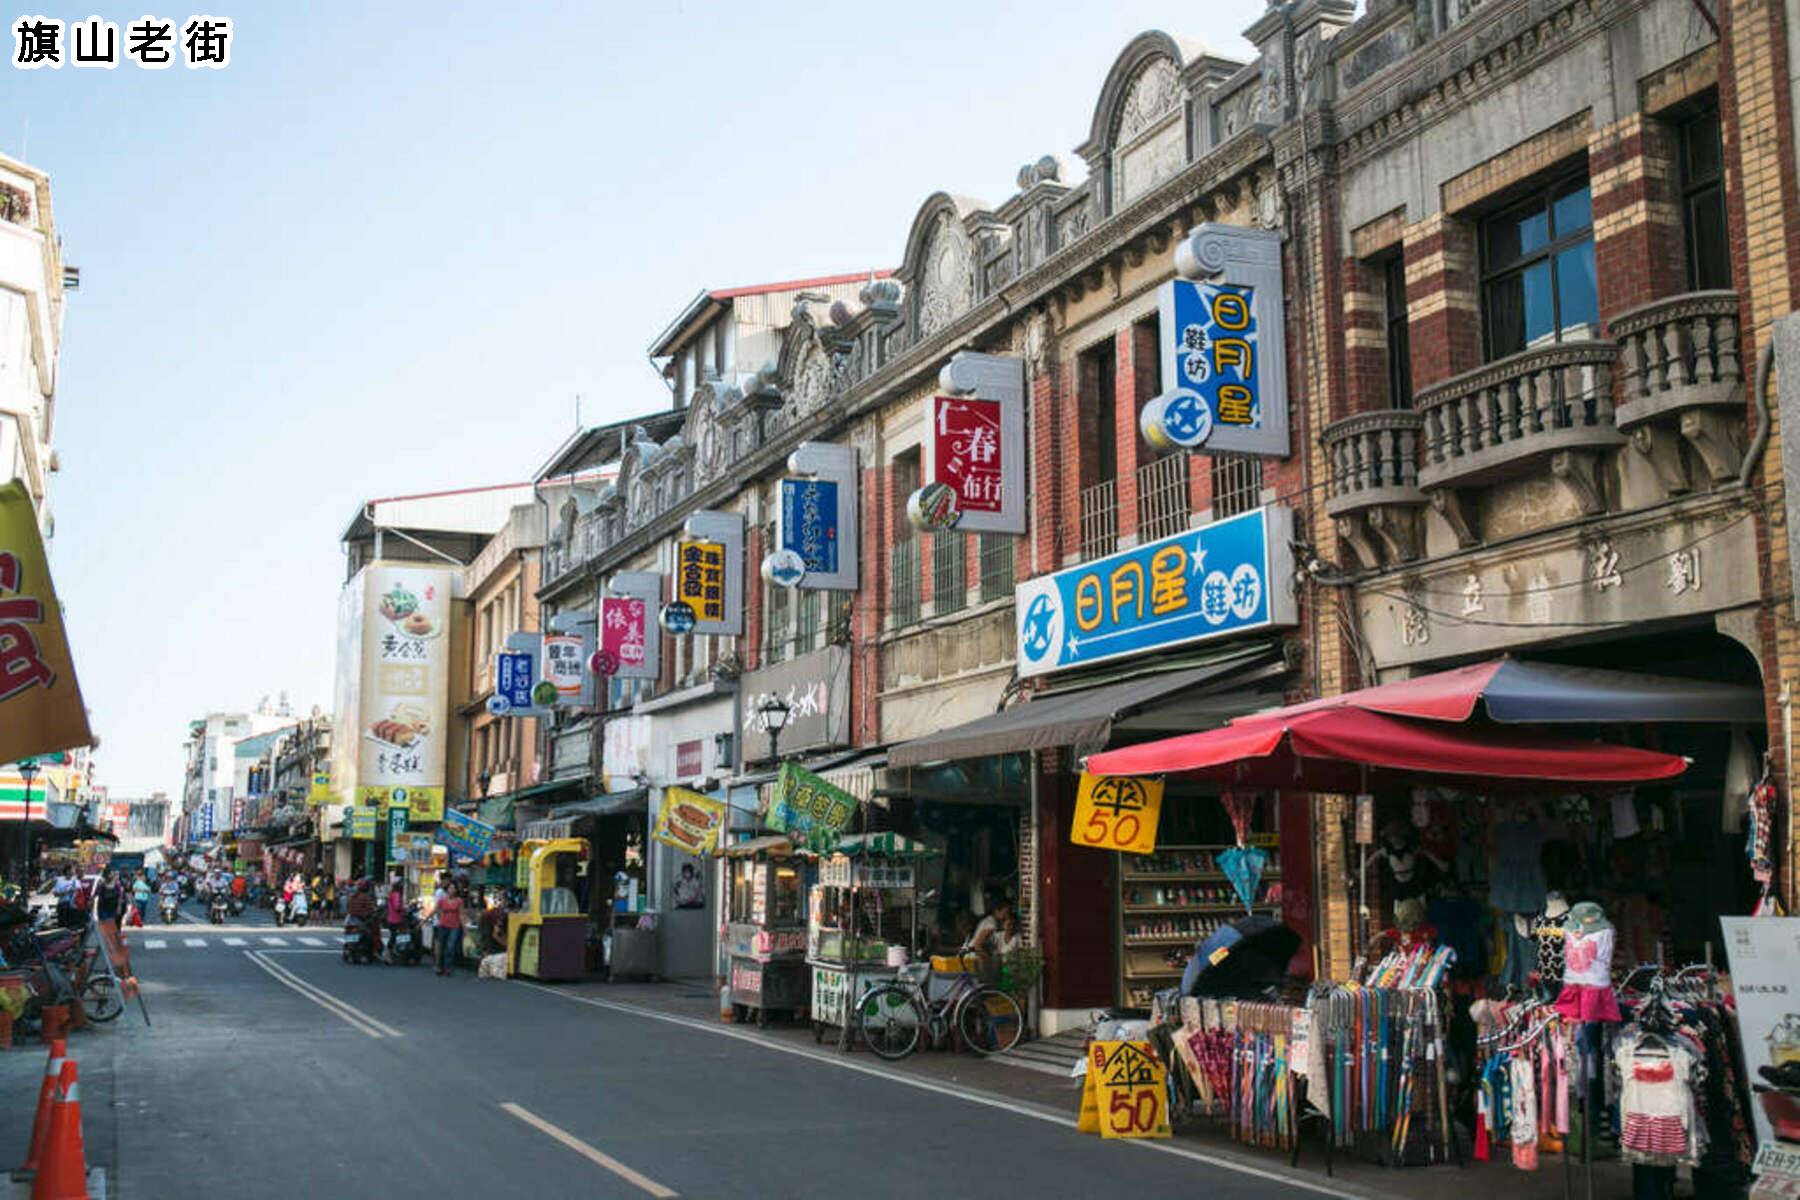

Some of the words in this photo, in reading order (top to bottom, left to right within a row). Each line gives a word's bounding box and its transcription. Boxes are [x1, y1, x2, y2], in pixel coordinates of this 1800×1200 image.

[1185, 328, 1207, 379] 鞋坊
[1211, 293, 1253, 424] 日月星
[1076, 545, 1189, 632] 日月星
[1206, 573, 1257, 617] 鞋坊
[1082, 809, 1140, 846] 50
[1110, 1089, 1159, 1134] 50
